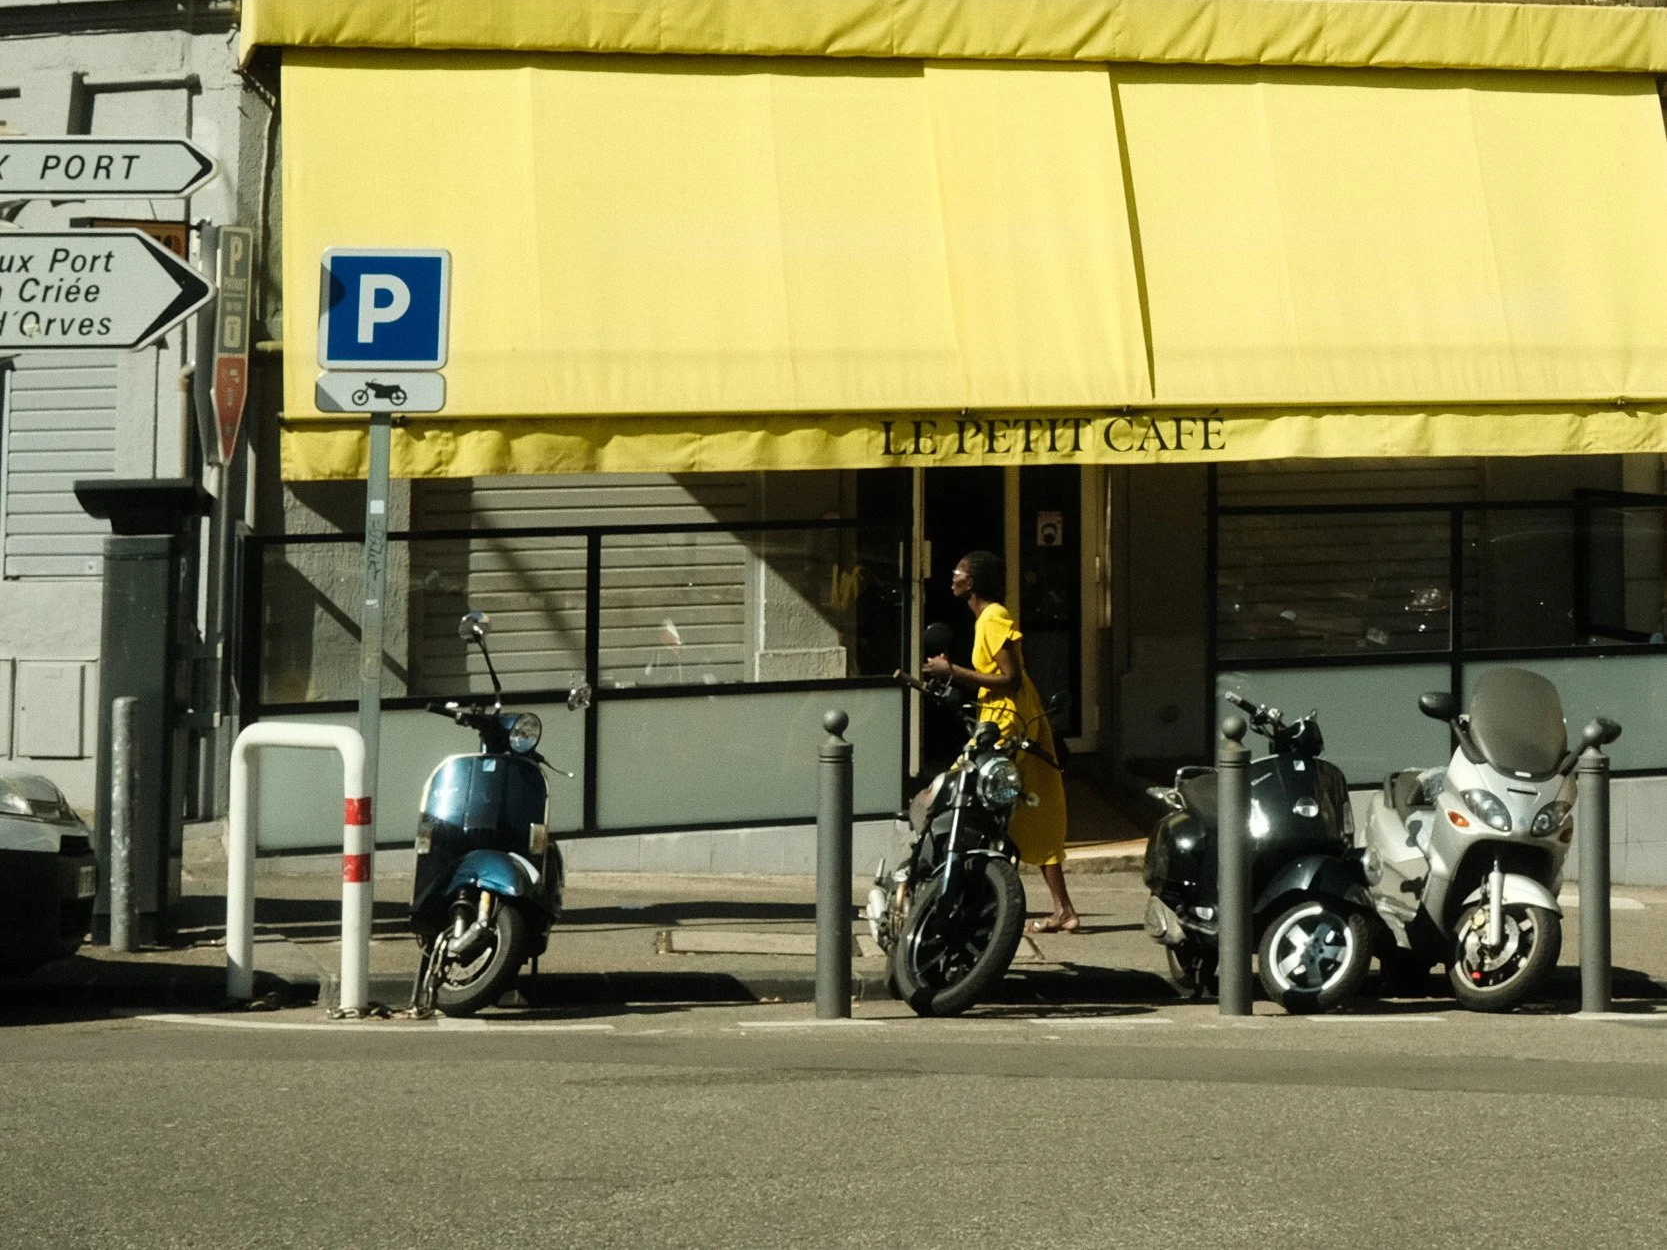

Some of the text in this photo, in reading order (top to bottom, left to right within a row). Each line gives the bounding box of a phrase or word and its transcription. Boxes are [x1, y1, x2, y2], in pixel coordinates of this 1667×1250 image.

[40, 154, 141, 180] PORT
[48, 248, 115, 274] Port
[18, 277, 101, 303] Criée
[357, 273, 412, 344] P
[880, 408, 1227, 457] LE PETIT CAFÉ
